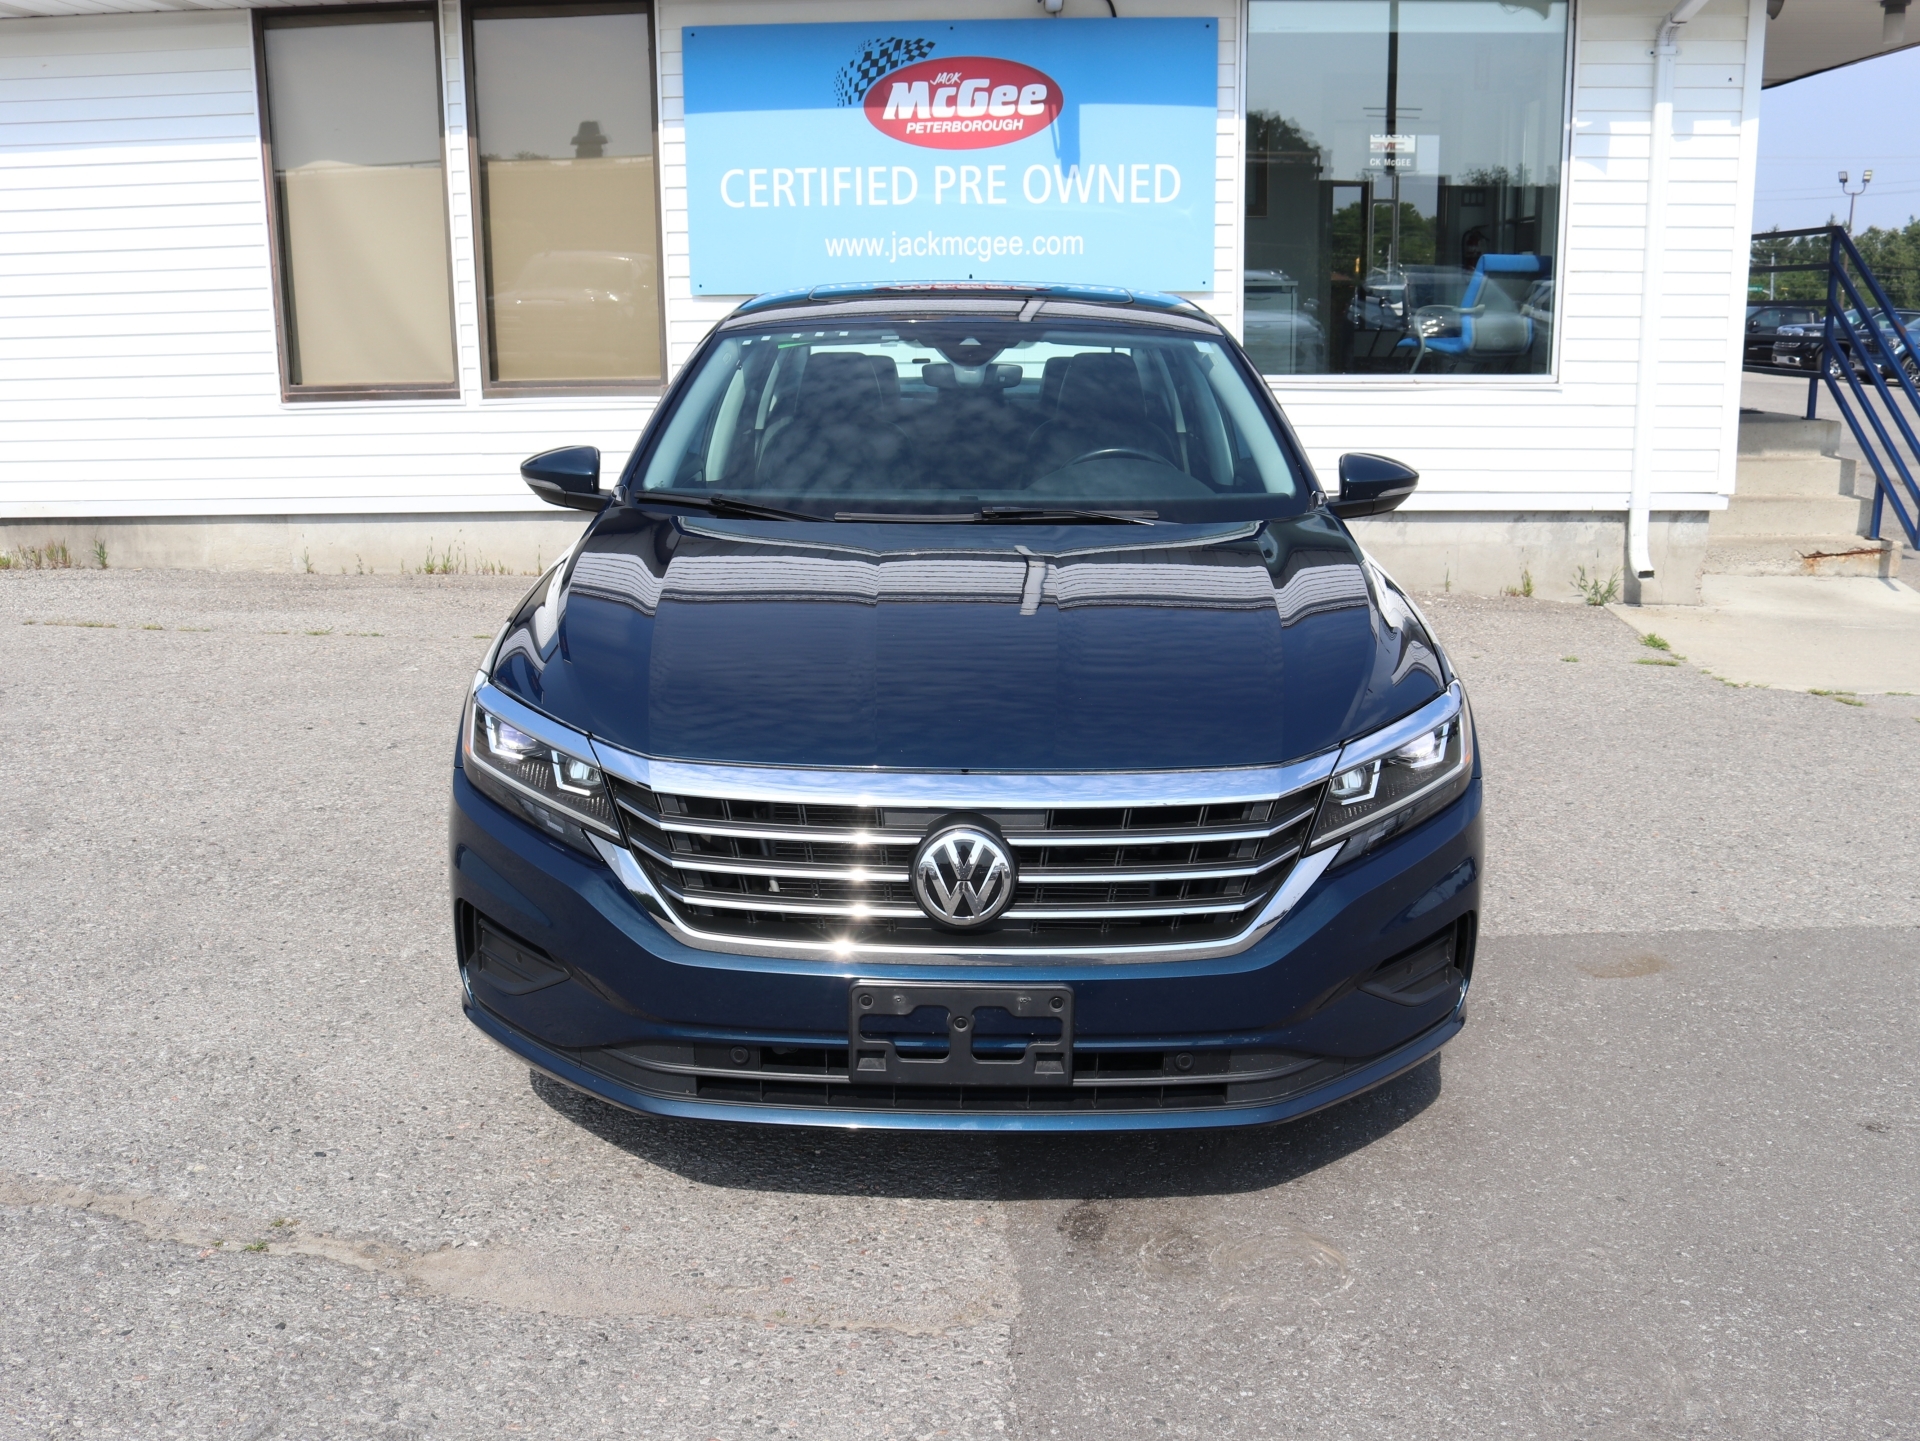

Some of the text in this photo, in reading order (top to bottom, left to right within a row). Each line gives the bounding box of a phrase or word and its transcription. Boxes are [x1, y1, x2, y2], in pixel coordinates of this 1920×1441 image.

[930, 72, 962, 86] JACK
[882, 78, 1048, 120] McGee
[906, 119, 1024, 135] PETERBOROUGH
[720, 163, 1182, 208] CERTIFIED PRE OWNED
[825, 230, 1084, 263] www.jackmcgee.com
